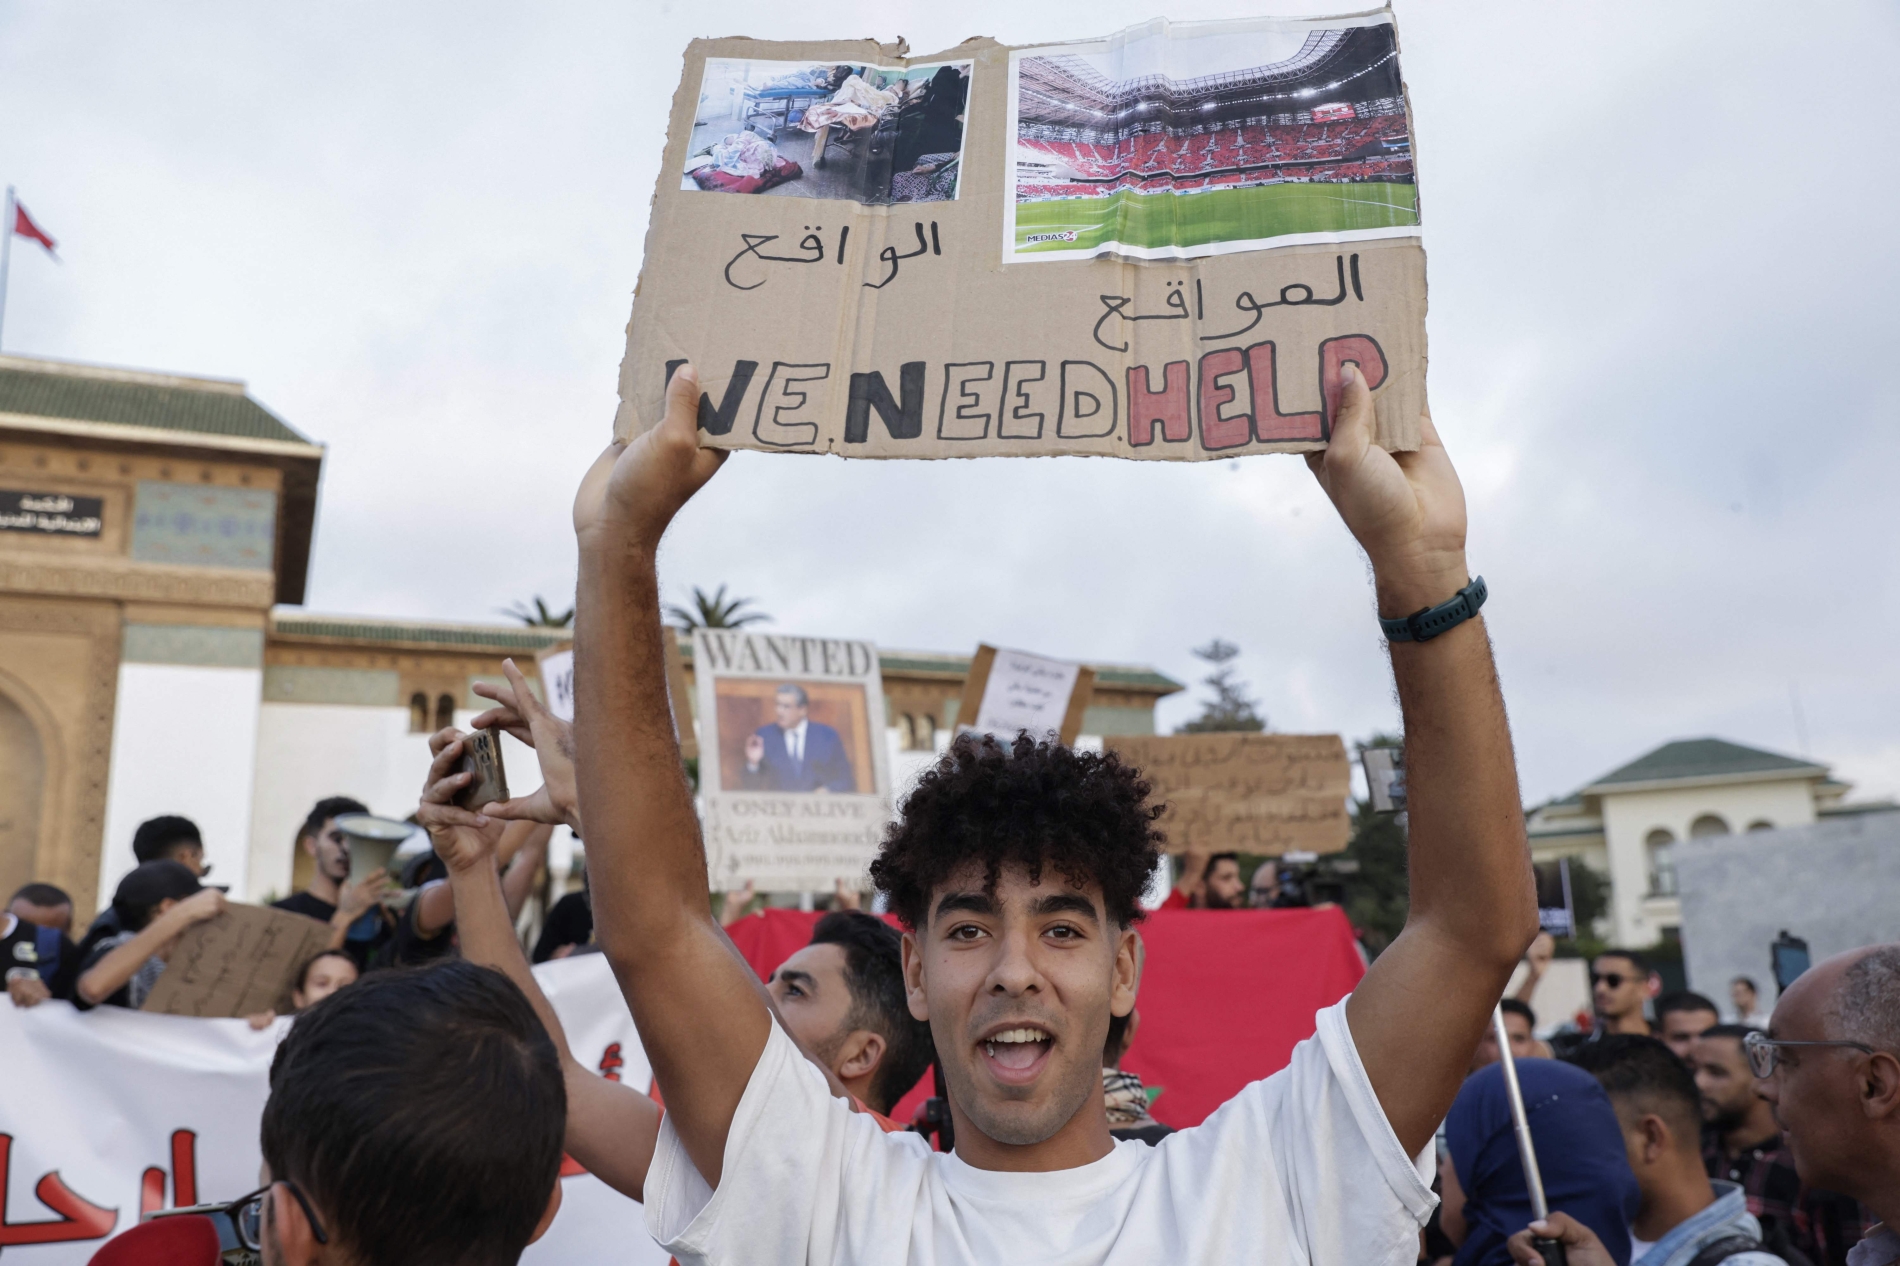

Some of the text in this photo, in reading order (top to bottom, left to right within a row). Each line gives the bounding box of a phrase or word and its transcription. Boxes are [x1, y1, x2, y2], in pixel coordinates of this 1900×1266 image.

[1093, 253, 1364, 352] المواقع
[1126, 333, 1388, 451] HELP
[701, 634, 872, 676] WANTED
[731, 799, 867, 819] ONLY ALIVE
